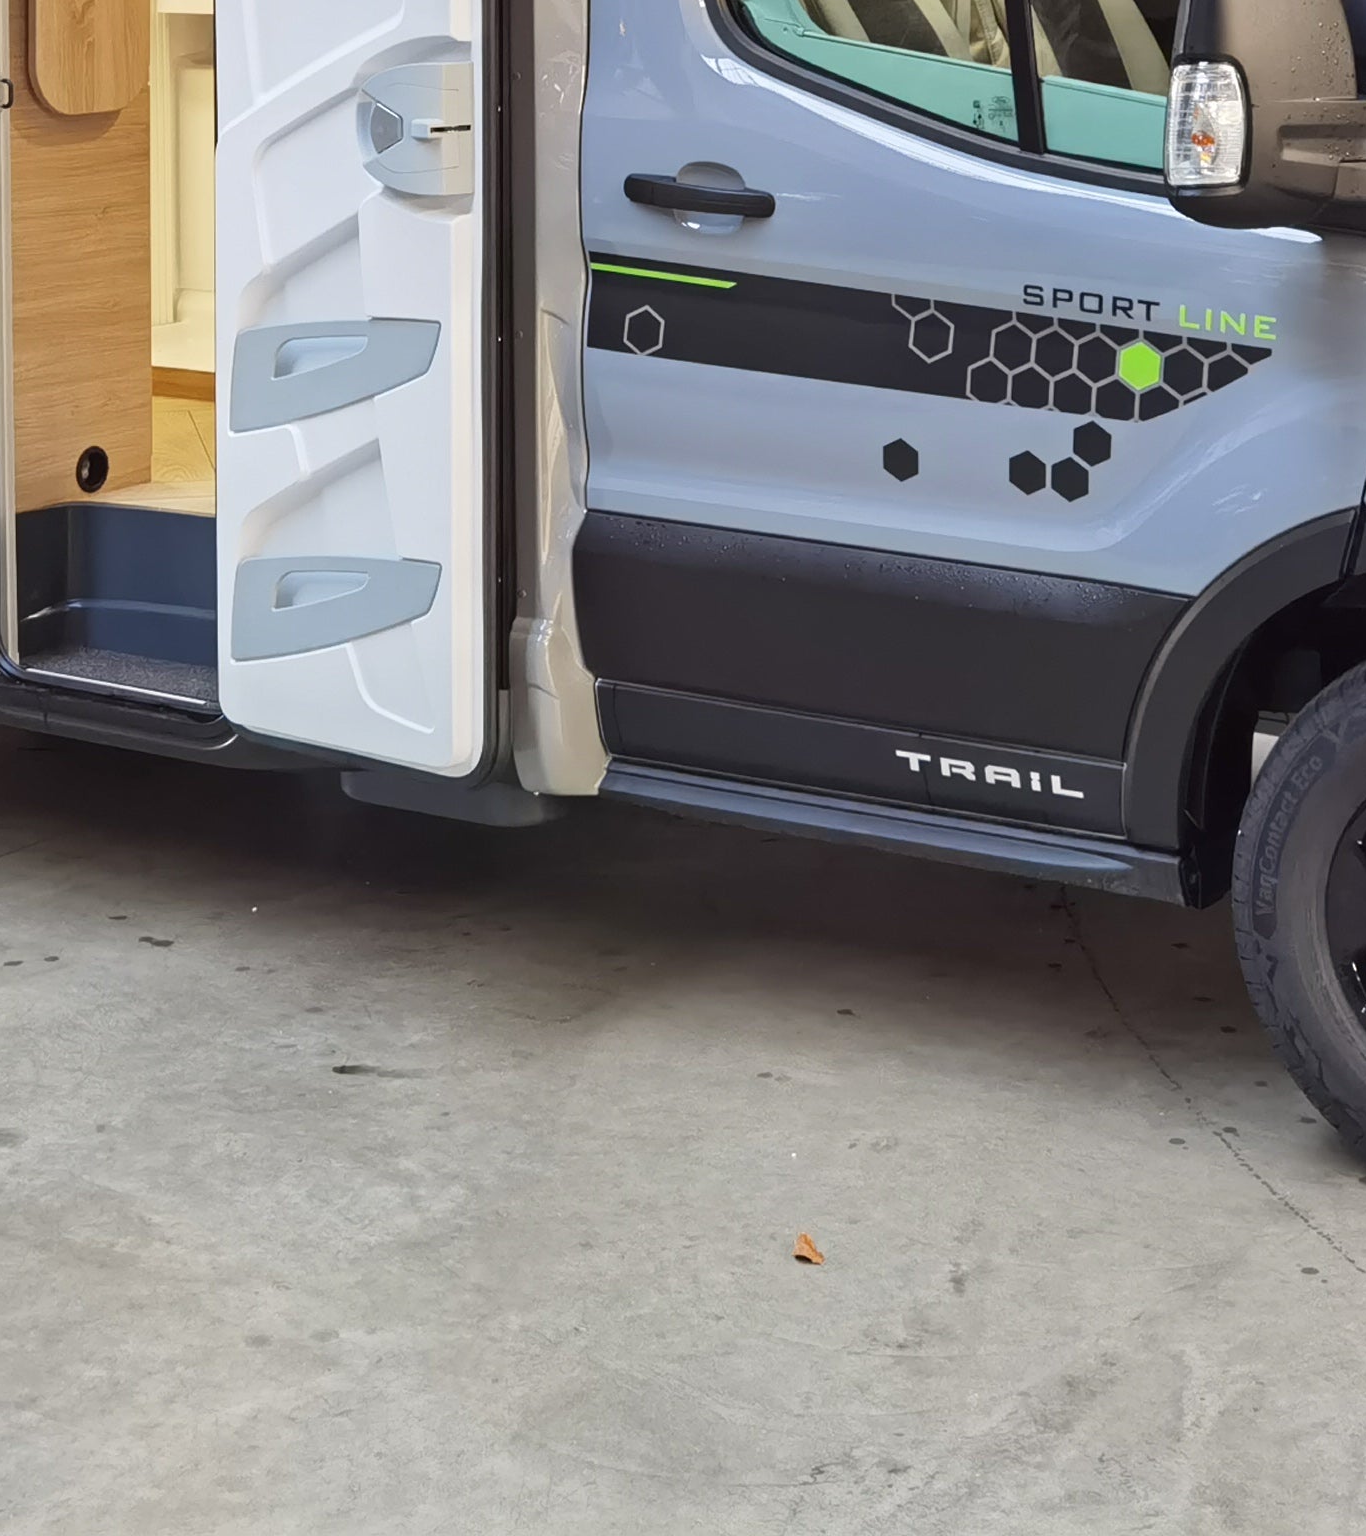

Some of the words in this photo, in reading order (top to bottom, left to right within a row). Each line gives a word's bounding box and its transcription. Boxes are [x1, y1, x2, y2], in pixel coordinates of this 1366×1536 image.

[1023, 284, 1160, 322] SPORT
[1178, 304, 1277, 340] LINE
[895, 749, 1084, 799] TRAIL
